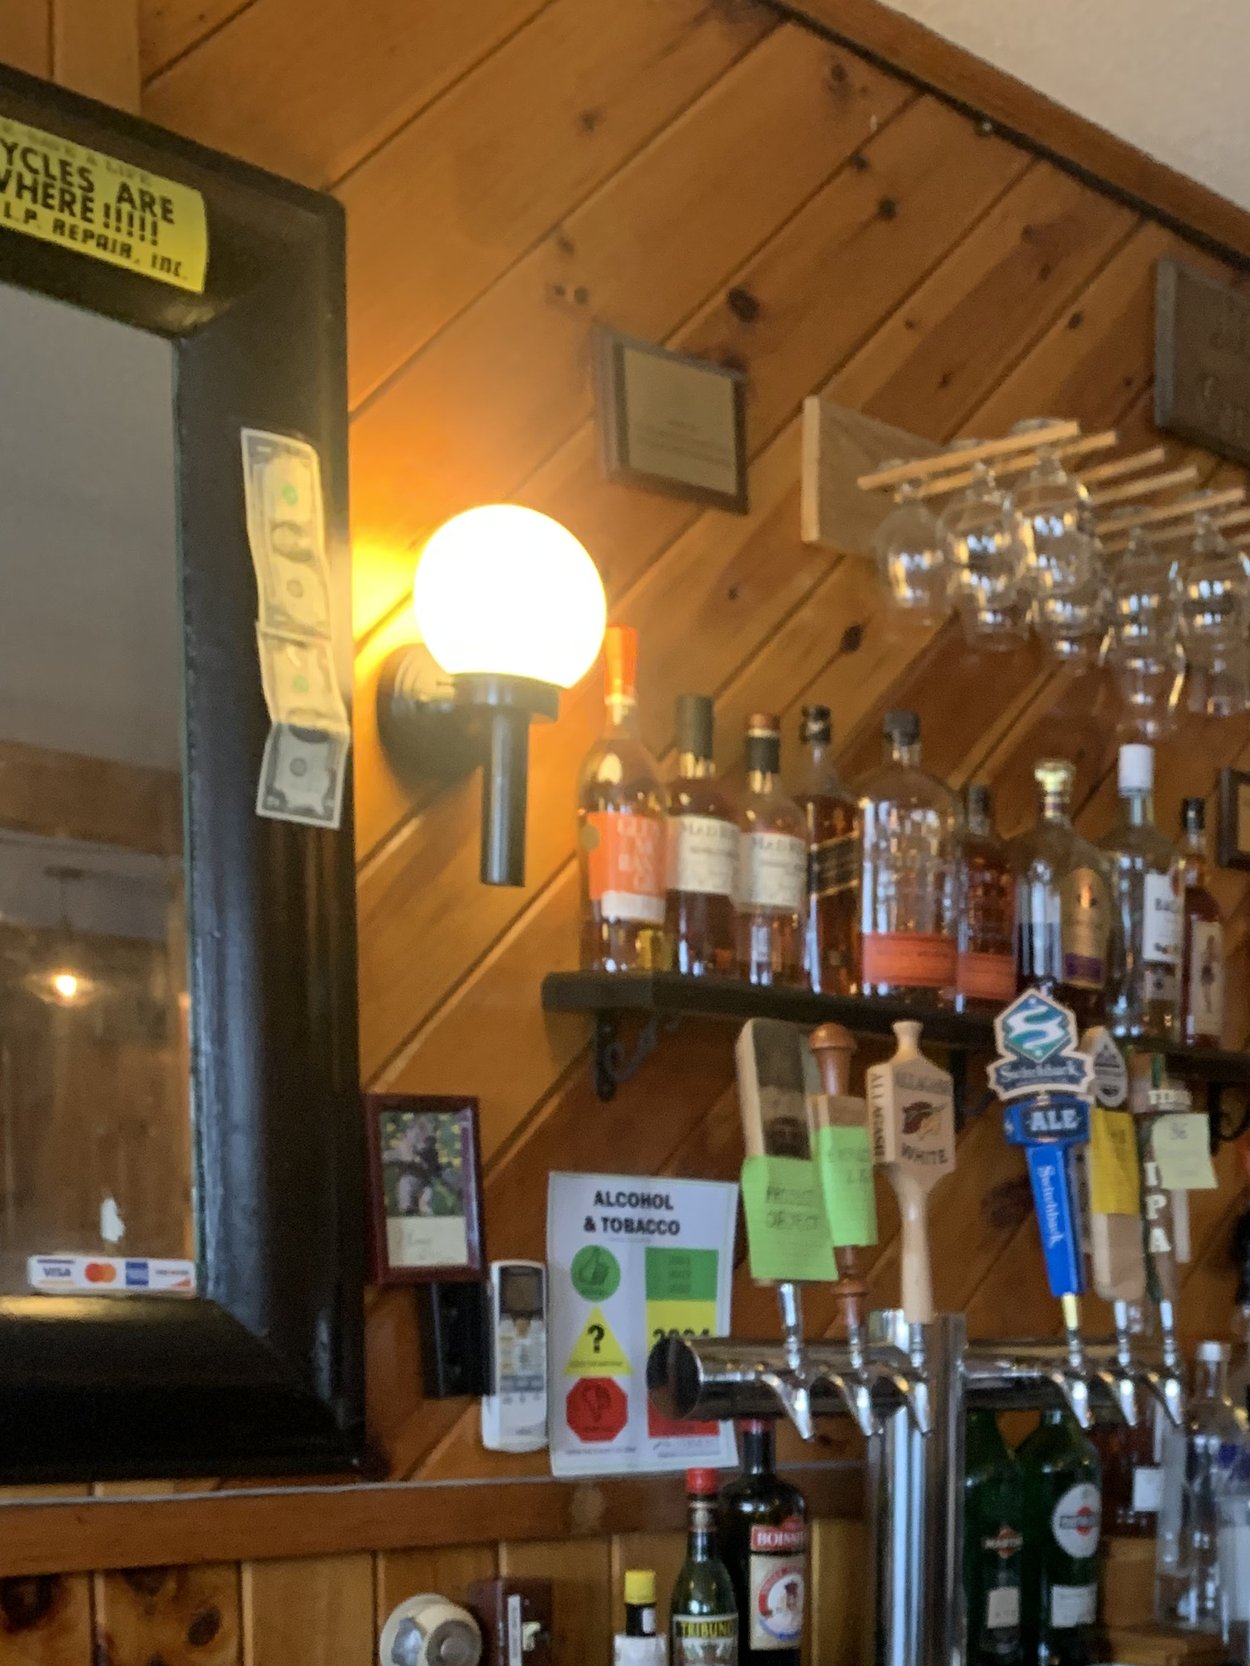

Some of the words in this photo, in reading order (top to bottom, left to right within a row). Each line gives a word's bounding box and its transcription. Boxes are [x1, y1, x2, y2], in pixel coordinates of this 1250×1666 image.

[116, 181, 176, 225] ARE
[1031, 1108, 1078, 1132] ALE
[901, 1142, 949, 1166] WHITE
[594, 1190, 675, 1211] ALCOHOL
[583, 1215, 597, 1233] &
[600, 1216, 681, 1236] TOBACCO
[43, 1267, 72, 1278] VISA
